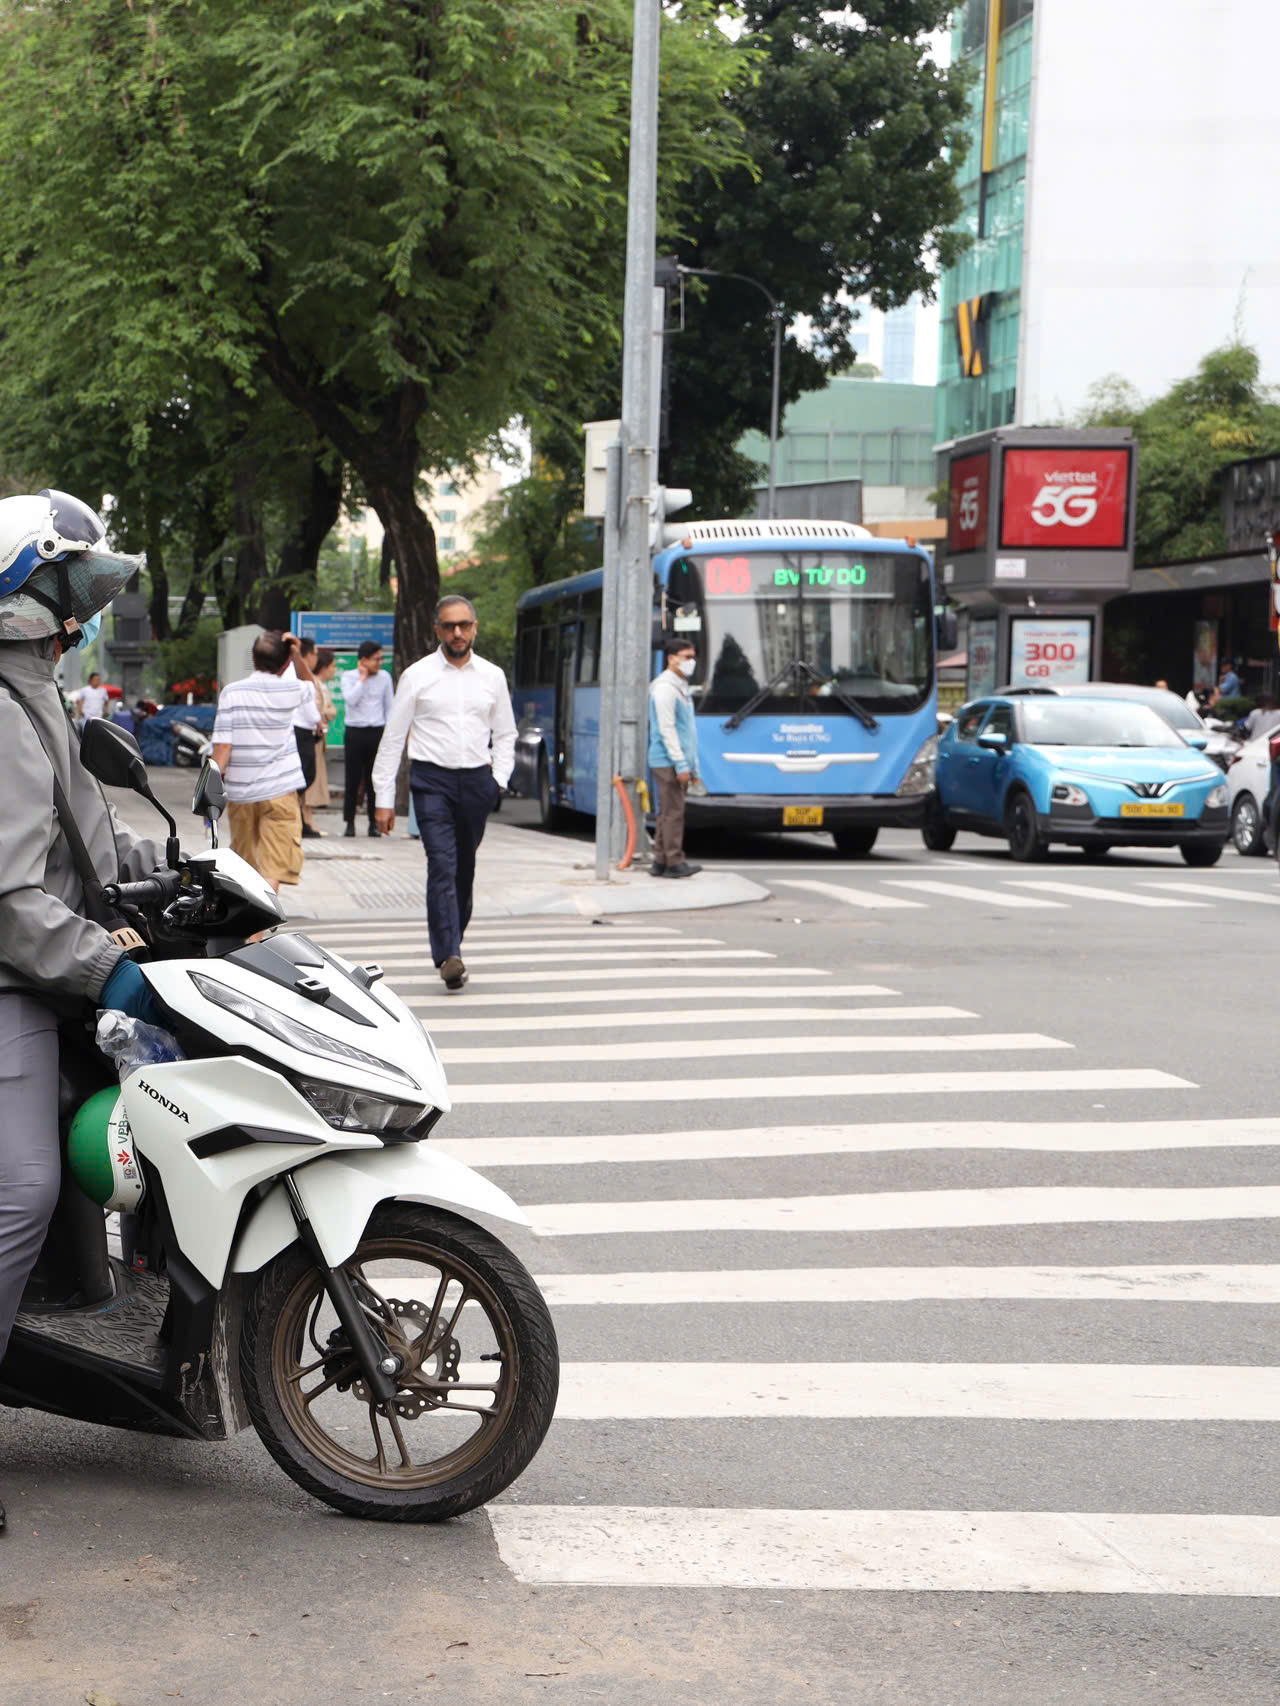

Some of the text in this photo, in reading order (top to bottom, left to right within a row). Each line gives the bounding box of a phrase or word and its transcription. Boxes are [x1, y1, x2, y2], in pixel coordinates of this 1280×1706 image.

[1044, 471, 1097, 483] viettel
[1031, 485, 1098, 527] 5G
[705, 557, 752, 594] 06
[774, 569, 800, 586] BV
[1025, 643, 1075, 661] 300
[1025, 664, 1050, 678] GB
[138, 1079, 191, 1124] HONDA
[117, 1104, 129, 1145] VPBa
